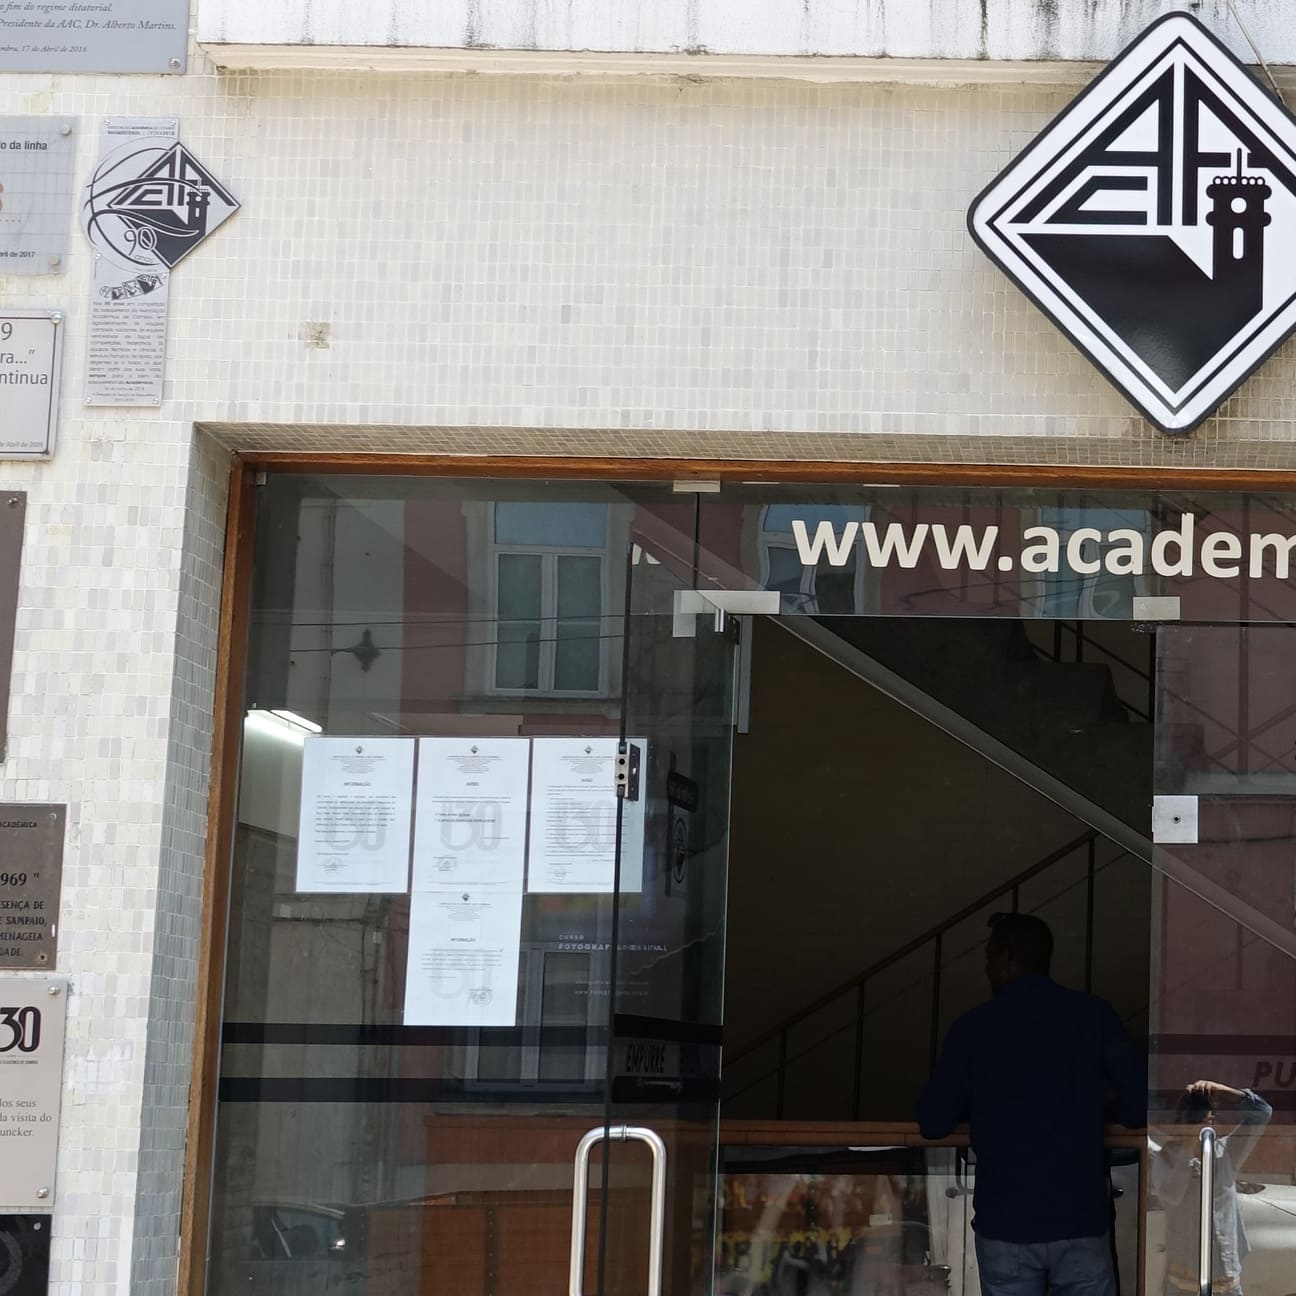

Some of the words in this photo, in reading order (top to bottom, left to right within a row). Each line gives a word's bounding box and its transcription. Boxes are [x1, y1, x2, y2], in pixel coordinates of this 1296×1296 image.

[4, 2, 21, 14] fim
[23, 2, 35, 12] do
[36, 3, 67, 14] regime
[68, 3, 113, 13] ditatorial.
[44, 19, 56, 29] da
[56, 19, 83, 30] AAC,
[85, 20, 101, 29] Dr.
[102, 19, 136, 30] Alberto
[137, 21, 178, 31] Martins.
[9, 141, 21, 150] da
[24, 141, 47, 151] linha
[124, 227, 157, 256] 90
[33, 901, 45, 910] DE
[6, 916, 48, 927] SAMPAIO,
[16, 1100, 37, 1108] seus
[11, 1112, 37, 1122] visita
[40, 1112, 52, 1122] do
